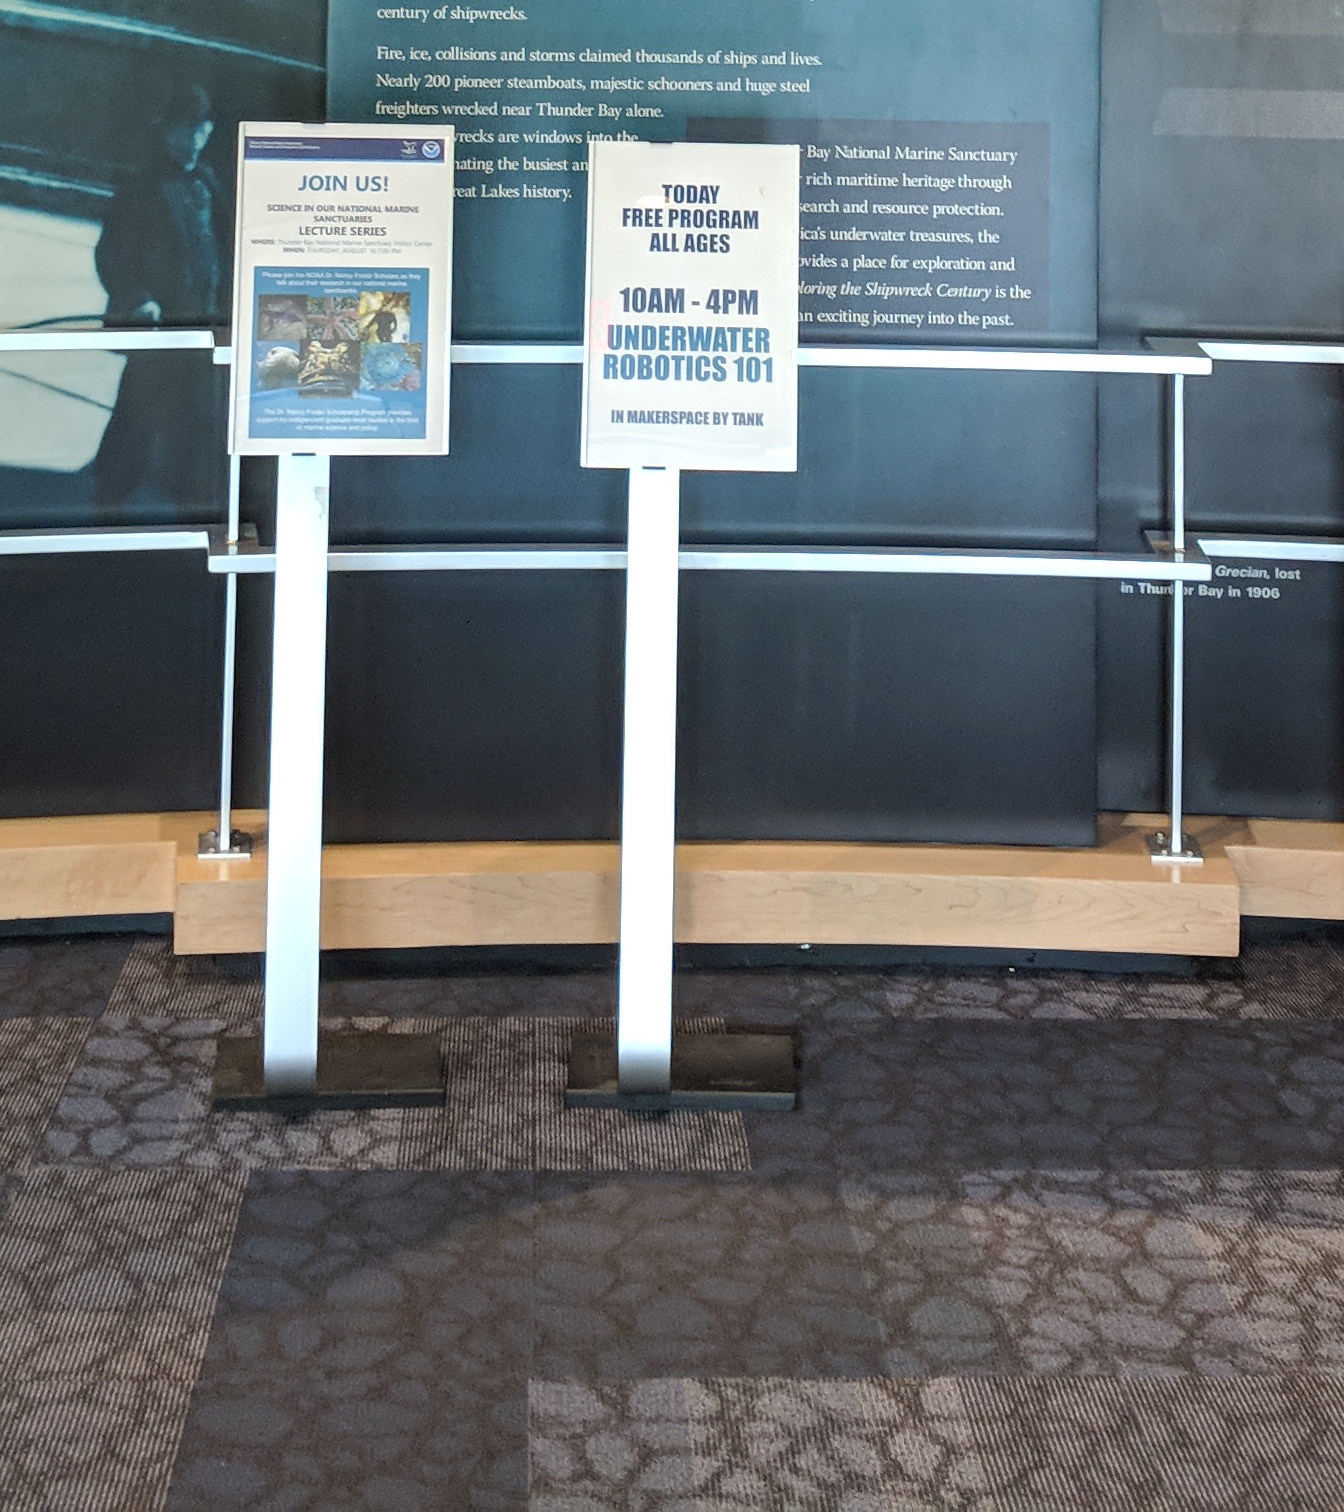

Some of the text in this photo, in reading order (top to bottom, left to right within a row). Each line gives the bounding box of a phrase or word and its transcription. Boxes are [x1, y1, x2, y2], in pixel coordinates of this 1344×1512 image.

[376, 4, 528, 24] century of shipwrecks.
[376, 45, 823, 69] Fire, ice, collisions and storms claimed thousands of ships and lives.
[375, 72, 811, 96] Nearly 200 pioneer steamboats, majestic schooners and huge steel
[374, 100, 665, 121] freighters wrecked near Thunder Bay alone.
[806, 144, 1019, 166] Bay National Marine Sanctuary
[297, 174, 389, 193] JOIN US!
[805, 171, 1013, 193] rich maritime heritage through
[661, 183, 721, 205] TODAY
[266, 203, 420, 214] SCIENCE IN OUR NATIONAL MARINE
[312, 214, 373, 224] SANCTUARIES
[621, 207, 759, 230] FREE PROGRAM
[841, 199, 1005, 219] and resource protection.
[298, 225, 388, 237] LECTURE SERIES
[648, 232, 731, 254] ALL AGES
[618, 286, 759, 316] 10AM 4PM
[606, 324, 771, 353] UNDERWATER
[602, 353, 774, 384] ROBOTICS 101
[610, 408, 765, 427] IN MAKERSPACE BY TANK
[1214, 564, 1301, 581] Grecian, lost
[1120, 581, 1134, 594] in
[1197, 583, 1224, 599] Bay
[1227, 585, 1242, 598] in
[1245, 586, 1281, 600] 1906
